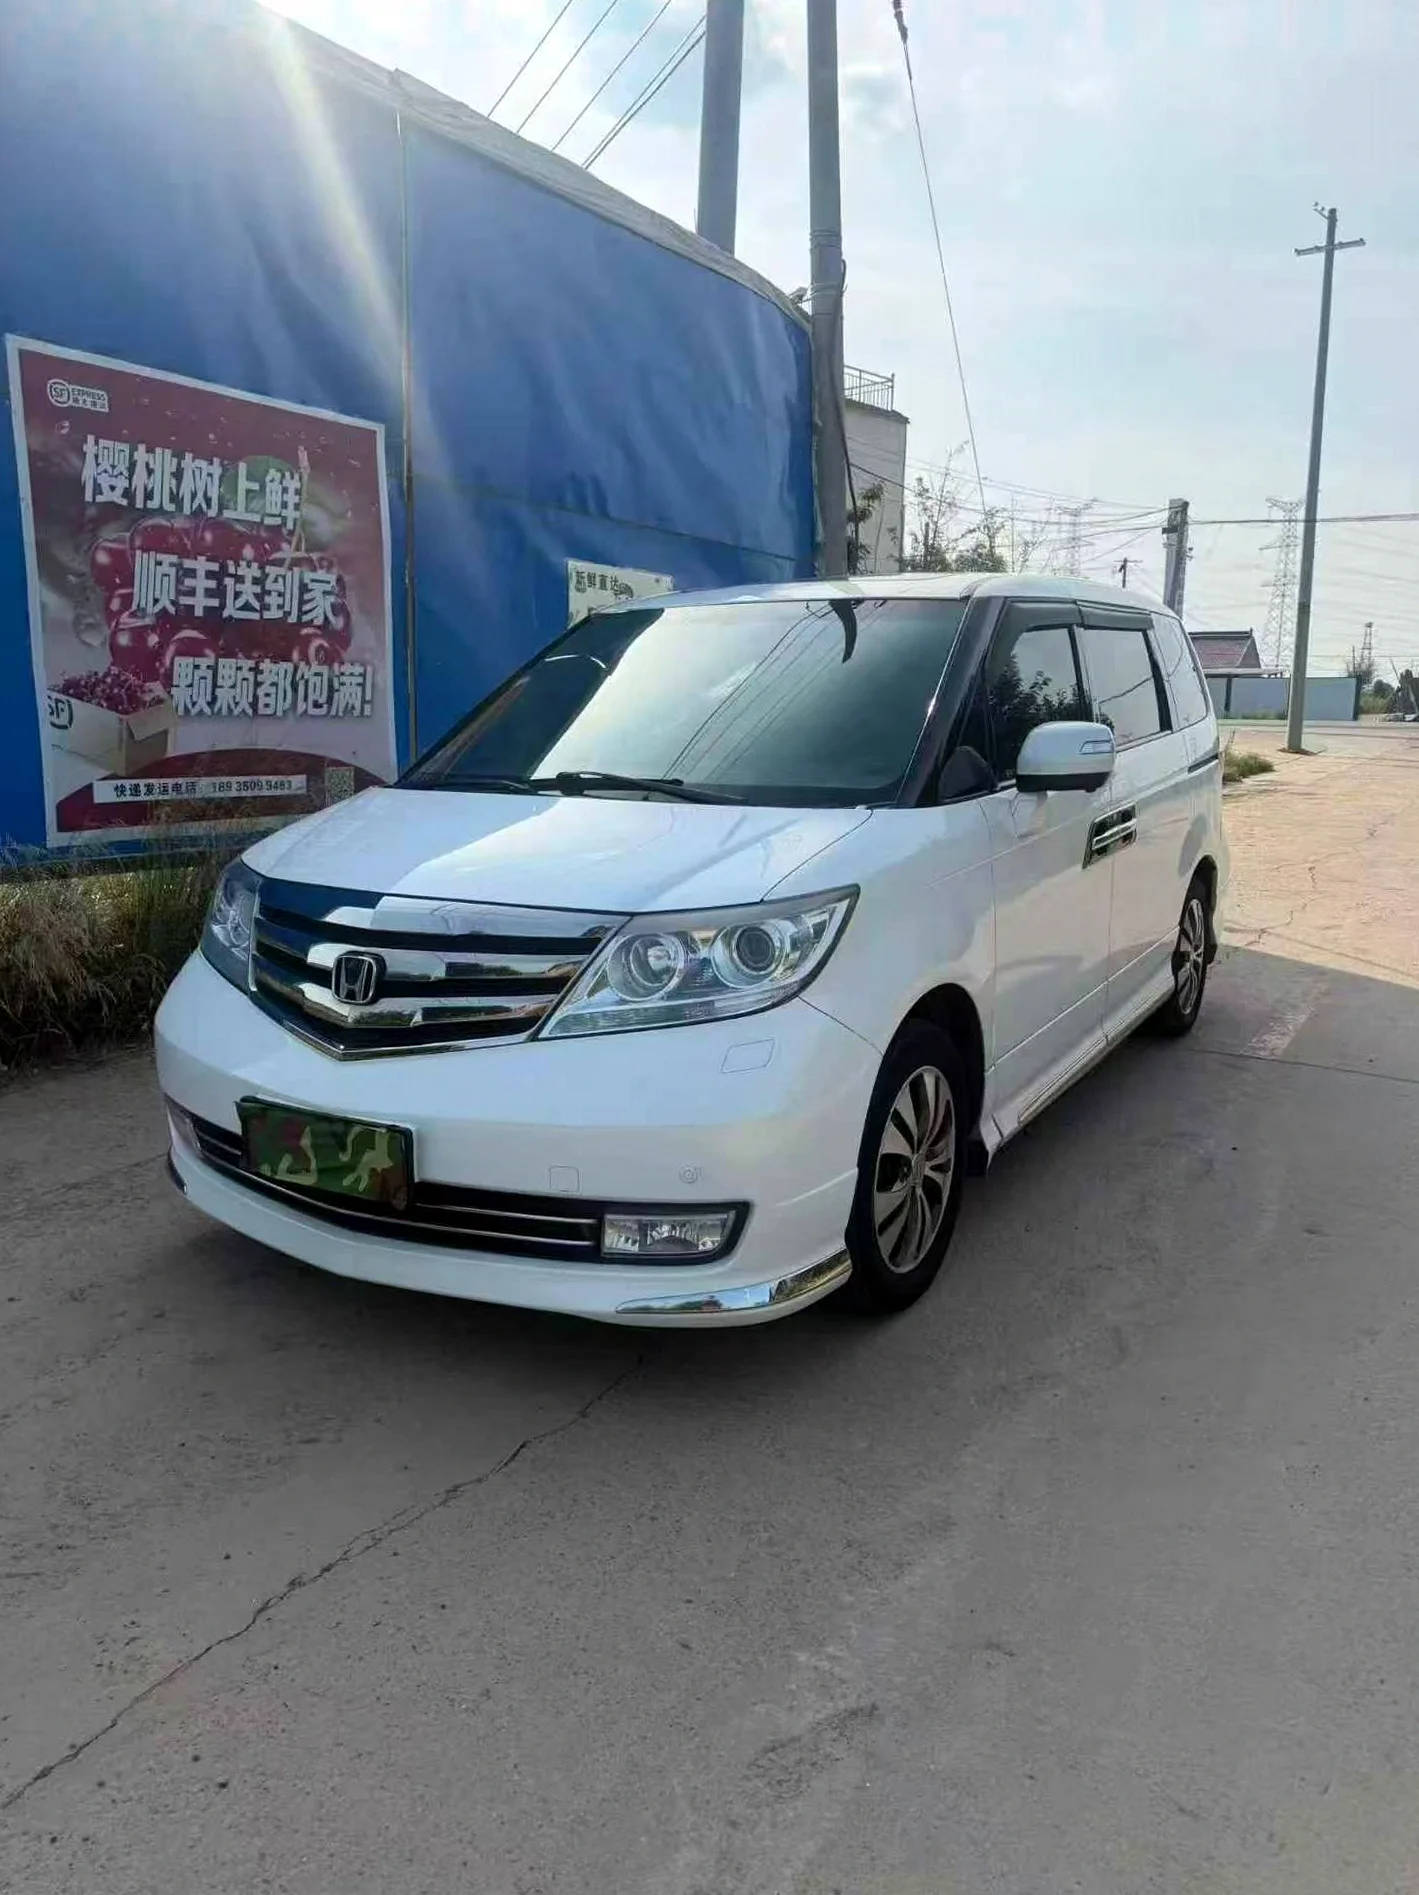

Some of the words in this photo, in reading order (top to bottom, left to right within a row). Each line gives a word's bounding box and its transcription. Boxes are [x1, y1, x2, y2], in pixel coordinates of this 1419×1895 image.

[51, 386, 66, 400] SF
[81, 434, 301, 530] 樱桃树上鲜
[131, 550, 343, 628] 顺丰送到家
[113, 781, 197, 797] 快递发运电话
